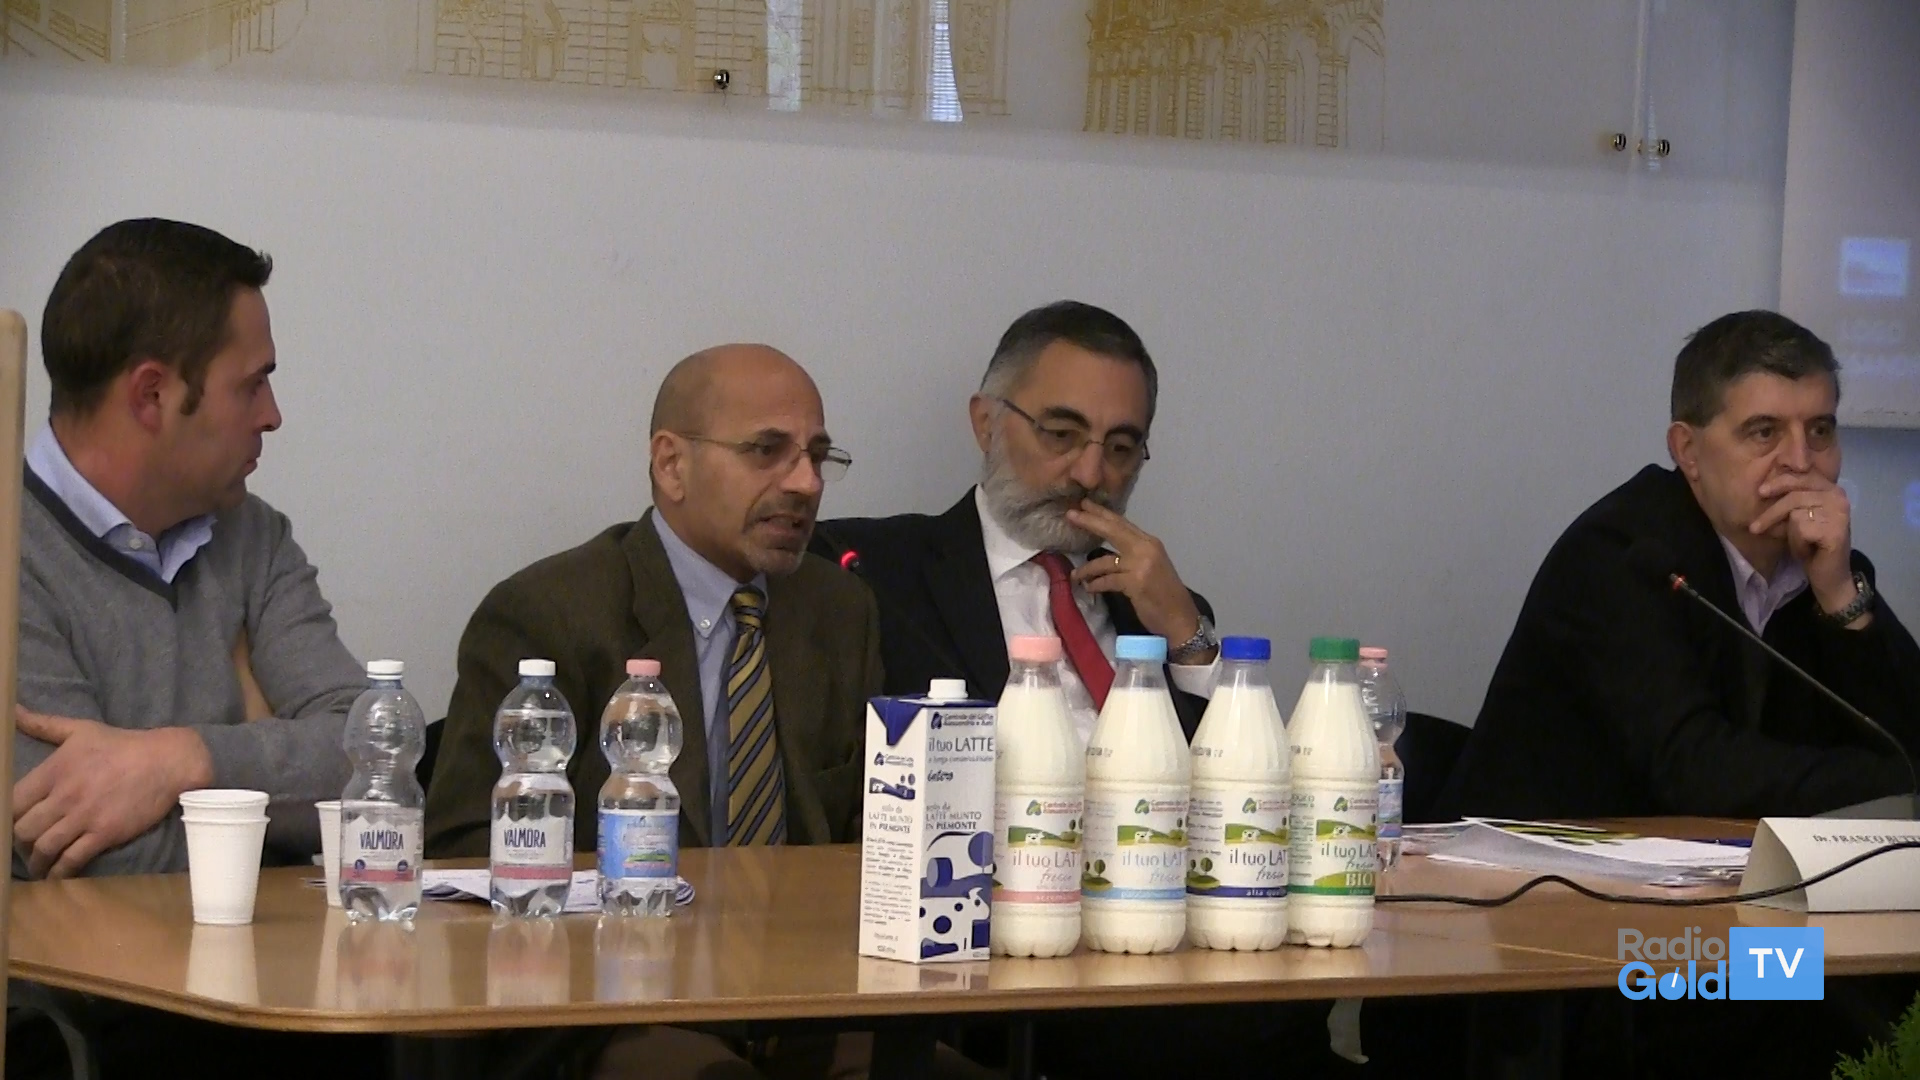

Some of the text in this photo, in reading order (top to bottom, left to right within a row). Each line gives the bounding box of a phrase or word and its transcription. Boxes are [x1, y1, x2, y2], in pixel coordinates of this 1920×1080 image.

[936, 738, 953, 752] tuo
[955, 737, 994, 752] LATTE
[950, 811, 982, 820] MUNTO
[936, 821, 977, 830] PIEMONTE
[360, 829, 404, 850] VALMORA
[503, 827, 546, 848] VALMORA
[1832, 835, 1885, 844] FRANCO
[1012, 850, 1021, 866] il
[1026, 852, 1051, 868] tuo
[1122, 850, 1130, 866] il
[1135, 852, 1159, 867] tuo
[1229, 848, 1238, 864] il
[1243, 851, 1266, 866] tuo
[1321, 843, 1330, 856] il
[1334, 846, 1357, 860] tuo
[1345, 873, 1373, 886] BIO
